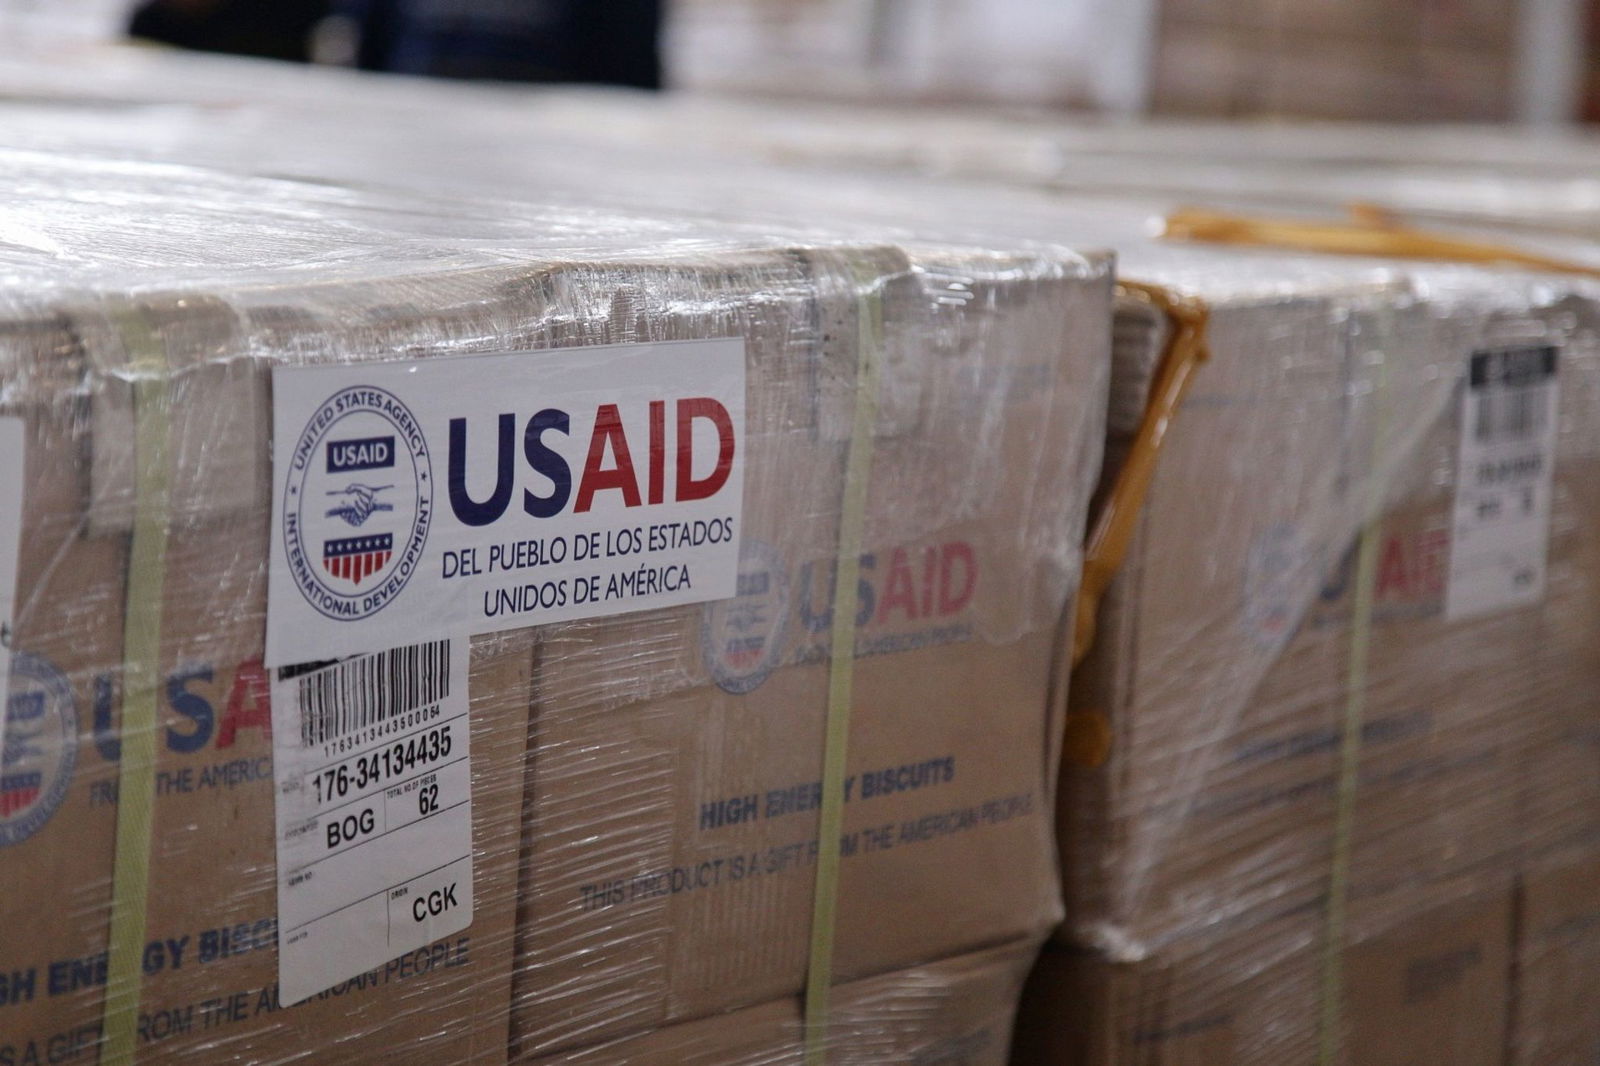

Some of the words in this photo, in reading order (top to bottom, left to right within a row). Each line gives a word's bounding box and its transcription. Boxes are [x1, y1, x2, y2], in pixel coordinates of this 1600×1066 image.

[295, 406, 333, 470] UNITED
[335, 391, 383, 413] STATES
[383, 399, 426, 458] AGENCY
[333, 442, 388, 467] USAID
[448, 396, 735, 527] USAID
[286, 512, 360, 615] INTERNATIONAL
[363, 495, 430, 612] DEVELOPMENT
[442, 548, 482, 579] DEL
[489, 536, 567, 573] PUEBLO
[573, 532, 600, 561] DE
[606, 527, 643, 557] LOS
[649, 516, 733, 552] ESTADOS
[484, 579, 567, 617] UNIDOS
[573, 575, 600, 604] DE
[605, 562, 691, 601] AMÉRICA
[156, 769, 195, 796] THE
[197, 756, 273, 790] AMERIC
[312, 725, 451, 805] 176-34134435
[699, 794, 758, 831] HIGH
[861, 756, 955, 799] BISCUITS
[327, 808, 375, 849] BOG
[419, 783, 439, 815] 62
[413, 882, 458, 922] CGK
[580, 879, 625, 910] THIS
[630, 859, 724, 902] PRODUCT
[199, 990, 248, 1029] THE
[384, 936, 471, 985] PEOPLE
